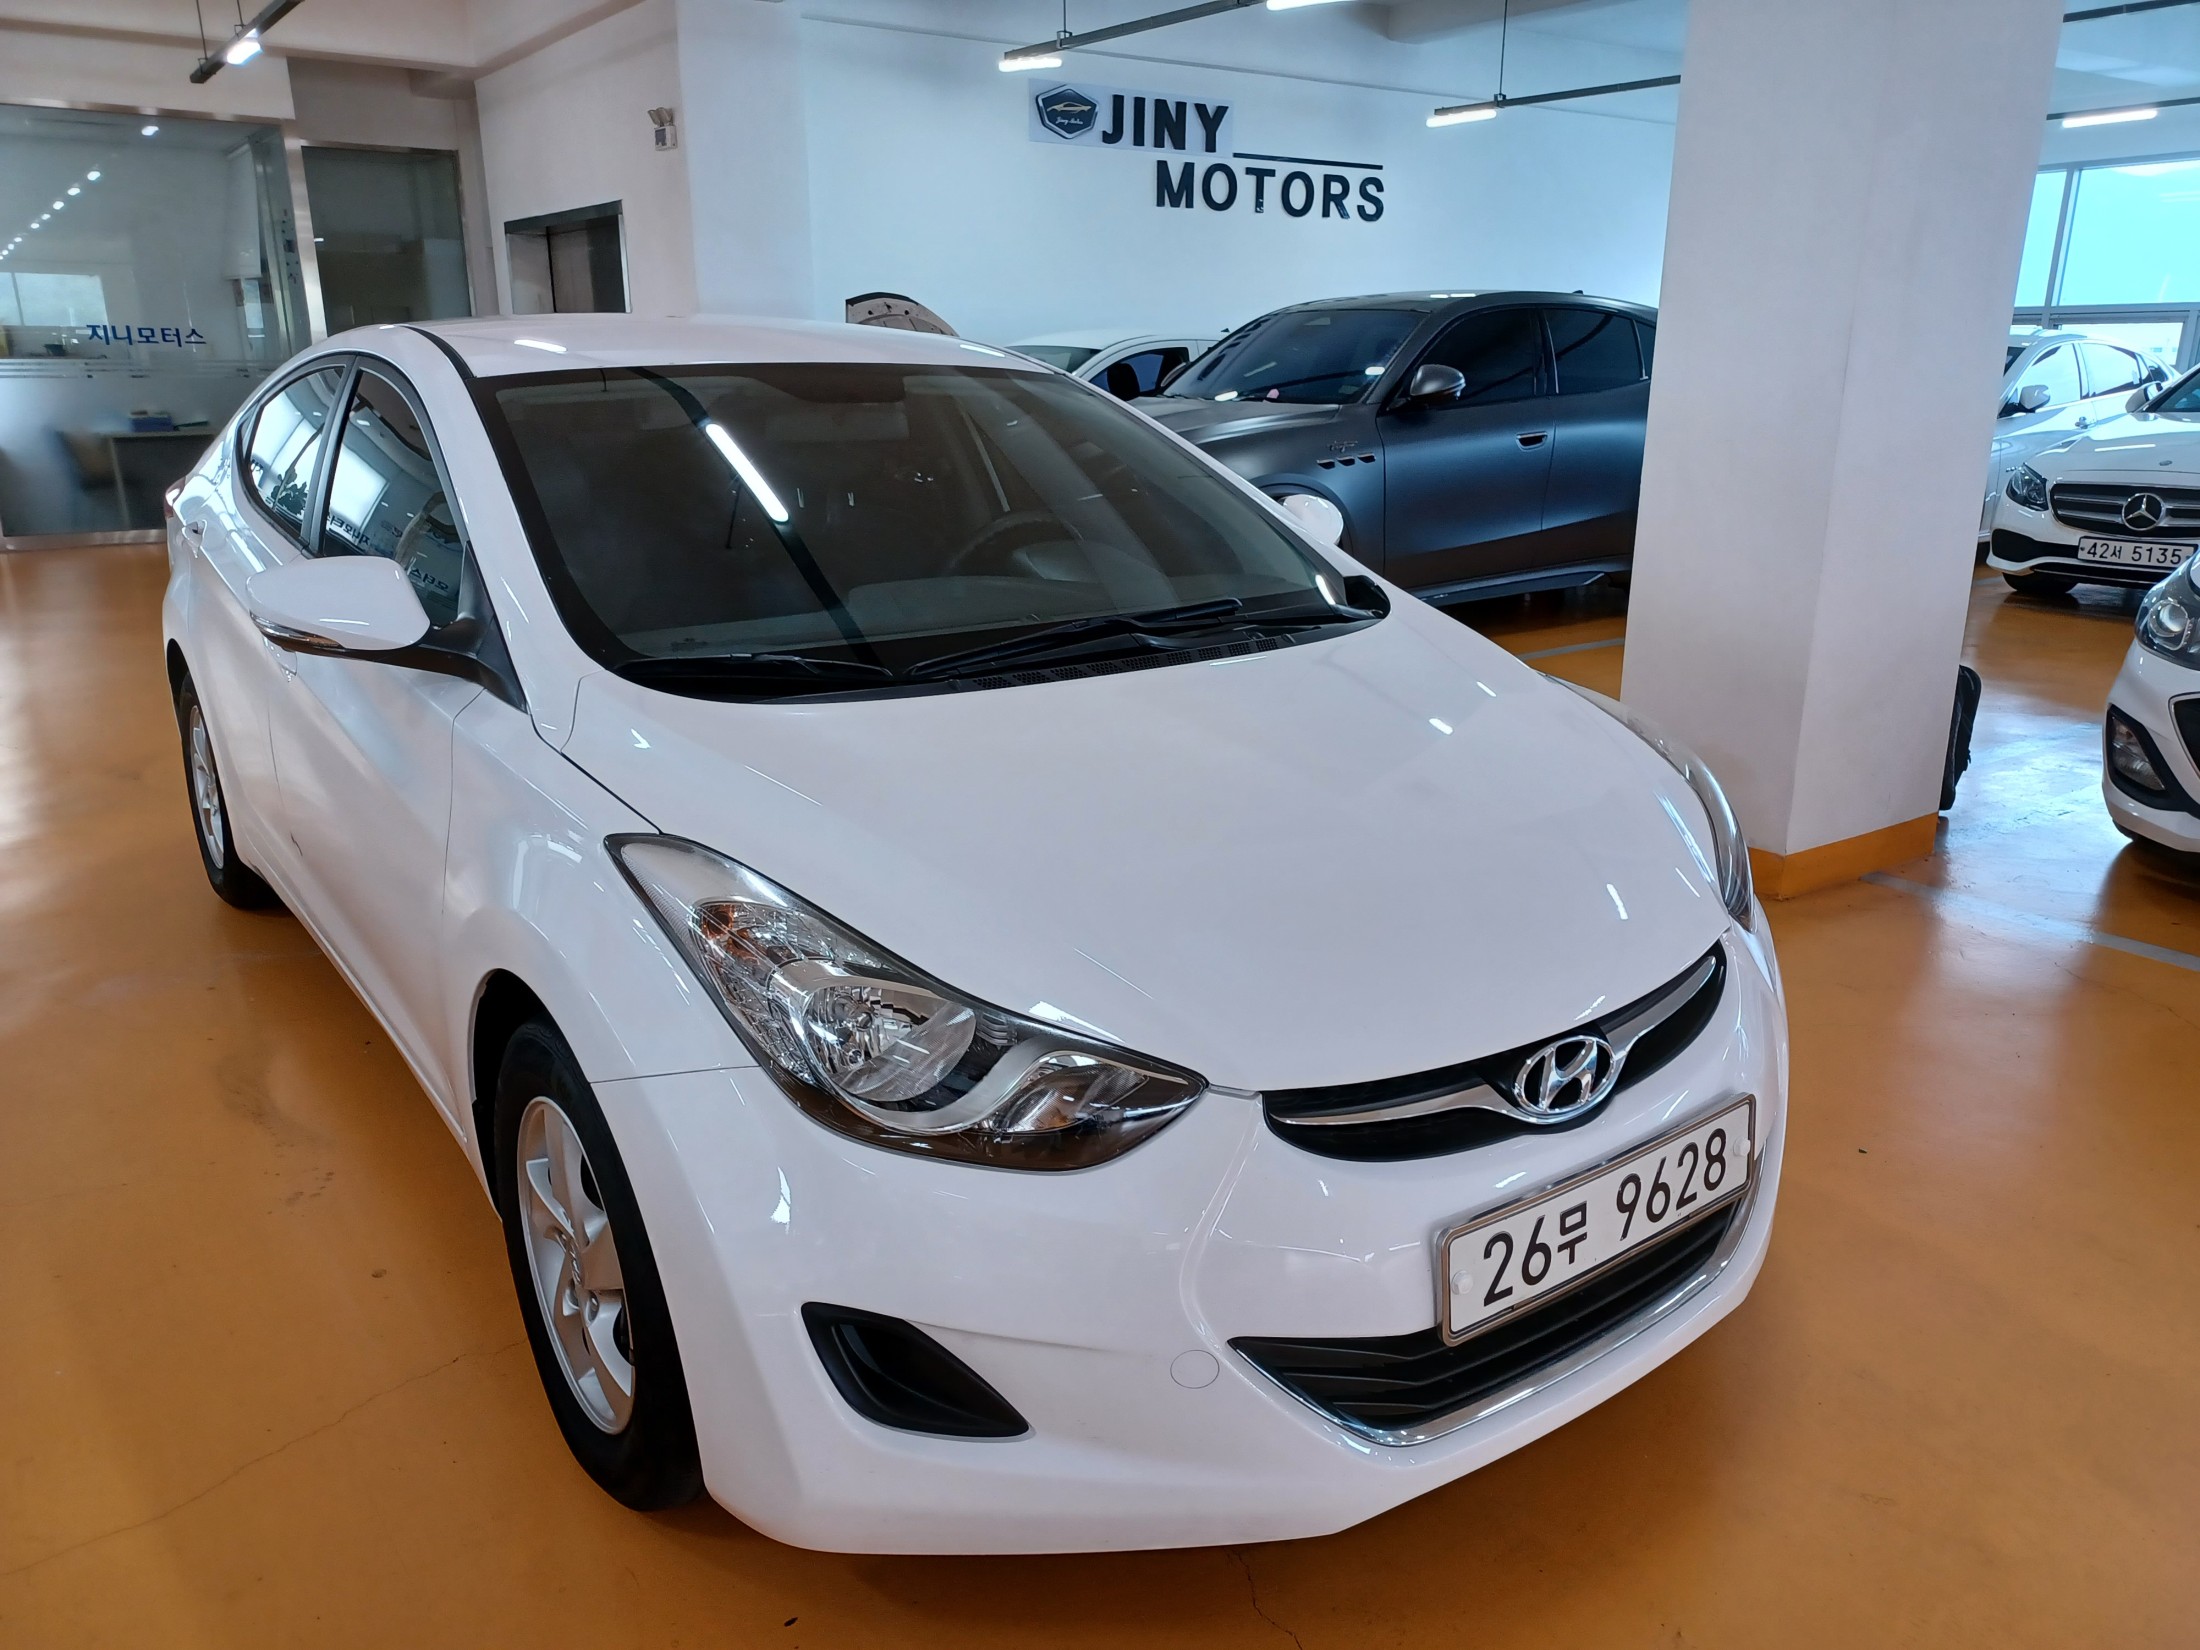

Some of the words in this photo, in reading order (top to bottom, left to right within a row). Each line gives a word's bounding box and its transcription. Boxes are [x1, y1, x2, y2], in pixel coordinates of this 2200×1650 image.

[1102, 94, 1229, 153] JINY
[1156, 160, 1385, 222] MOTORS
[86, 324, 207, 348] 지니모터스
[2087, 542, 2122, 559] 42서
[2131, 545, 2183, 565] 5135
[1483, 1200, 1588, 1307] 26무
[1616, 1128, 1727, 1242] 9628
